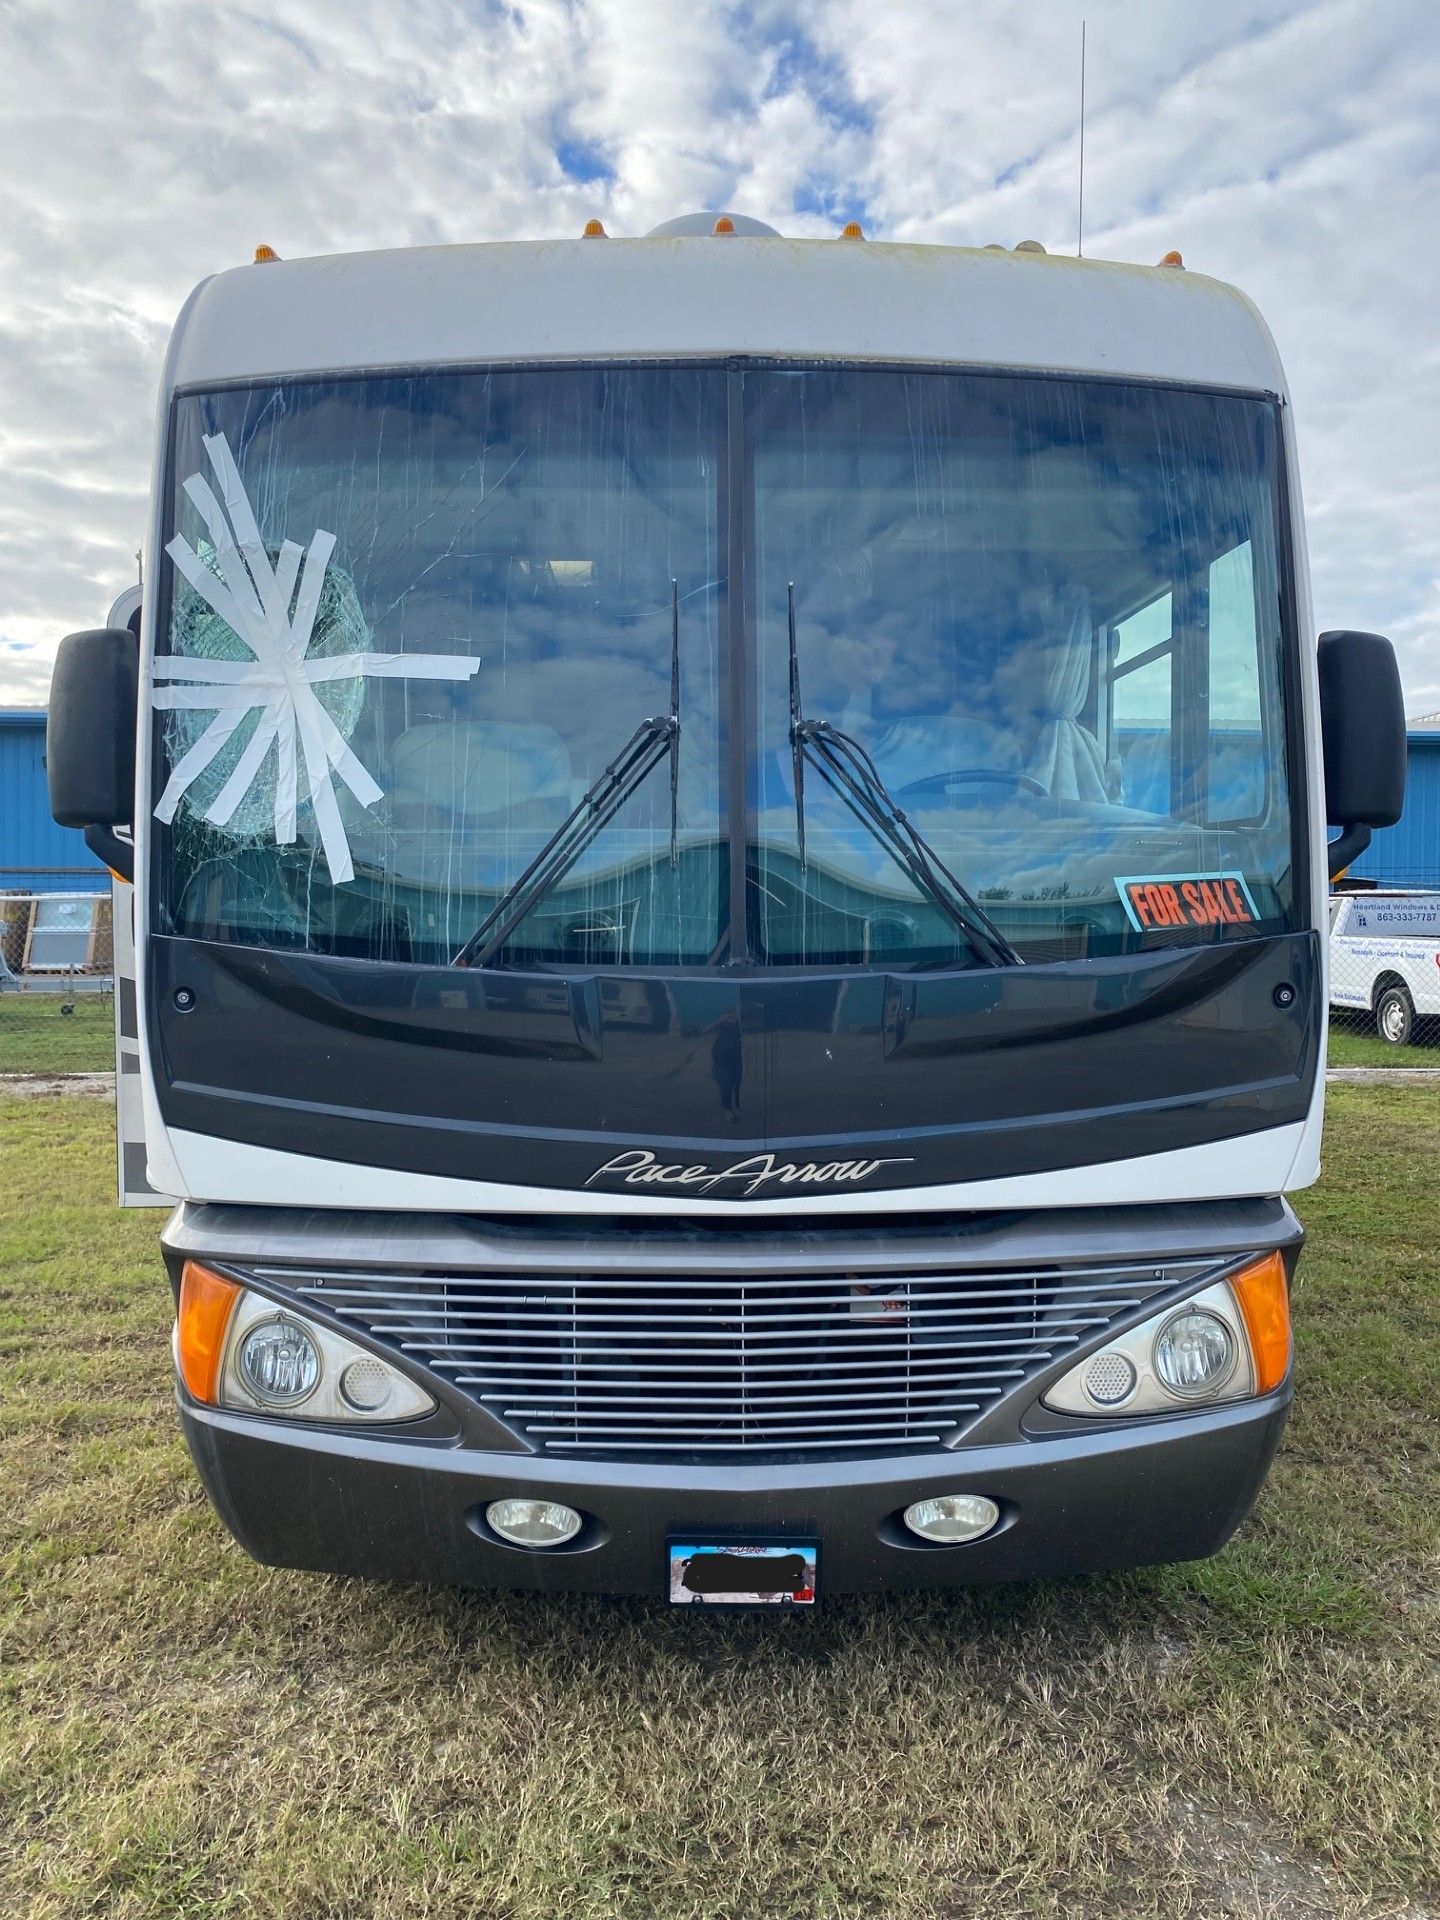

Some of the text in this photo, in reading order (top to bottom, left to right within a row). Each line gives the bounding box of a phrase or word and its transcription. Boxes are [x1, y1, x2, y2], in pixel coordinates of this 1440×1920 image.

[1129, 881, 1252, 925] FOR SALE
[1377, 912, 1437, 922] 863-333-7787
[584, 1150, 915, 1195] Pace Arrow
